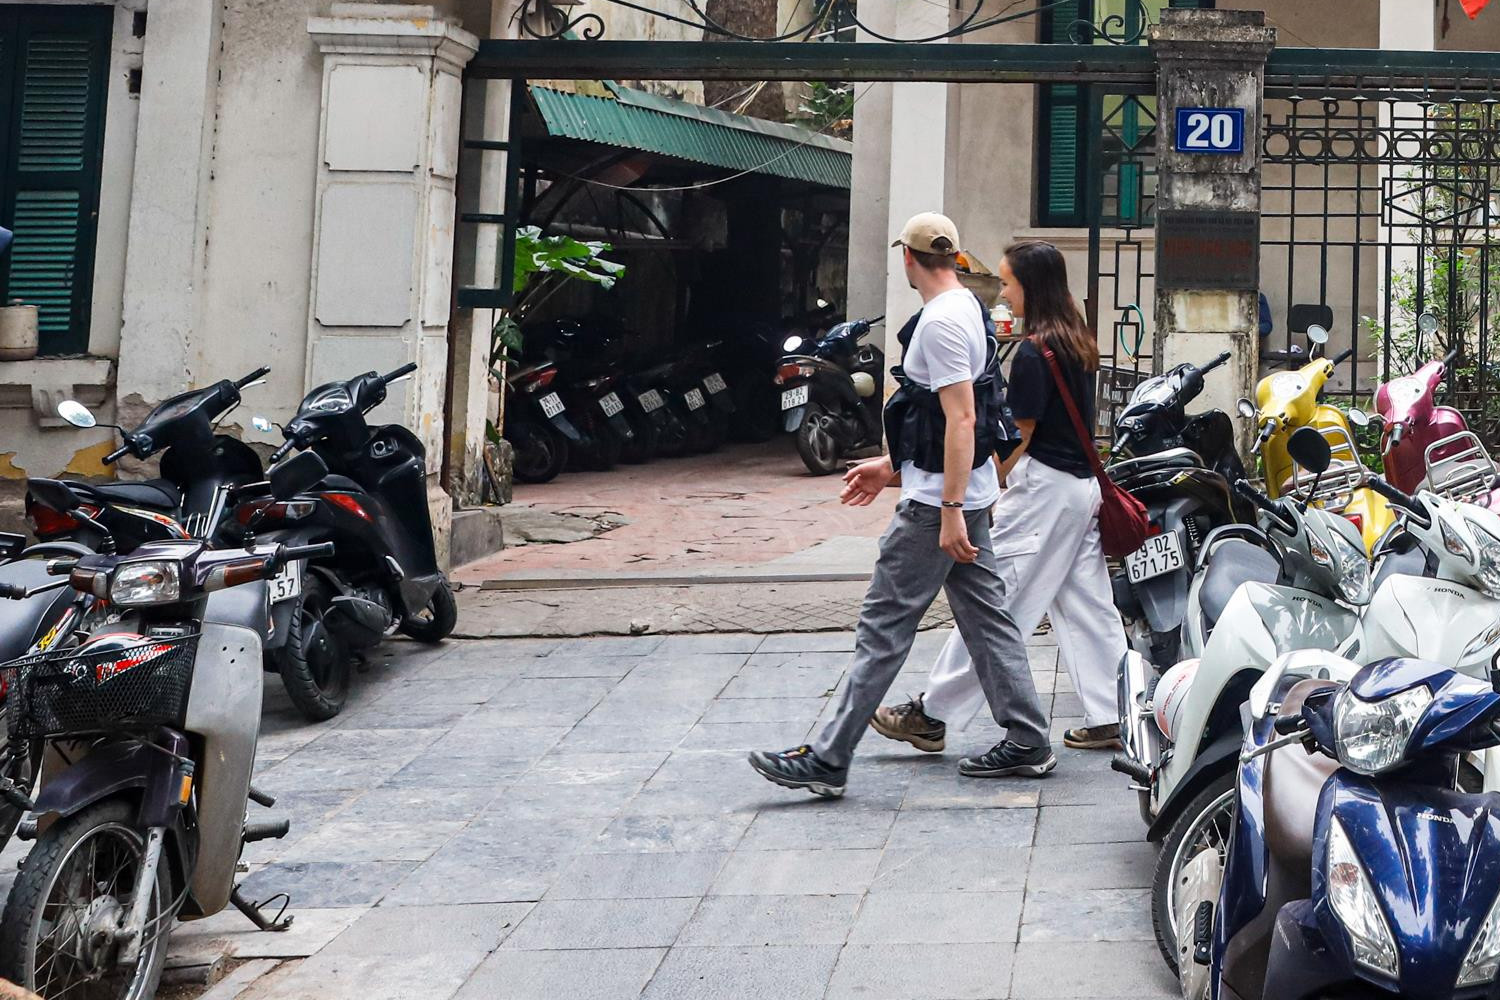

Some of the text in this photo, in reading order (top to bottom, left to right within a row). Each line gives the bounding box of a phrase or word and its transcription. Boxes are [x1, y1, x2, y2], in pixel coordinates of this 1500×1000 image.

[1186, 113, 1233, 148] 20
[1132, 551, 1179, 579] 671.75
[1292, 596, 1323, 609] HONDA
[1434, 587, 1466, 600] HONDA
